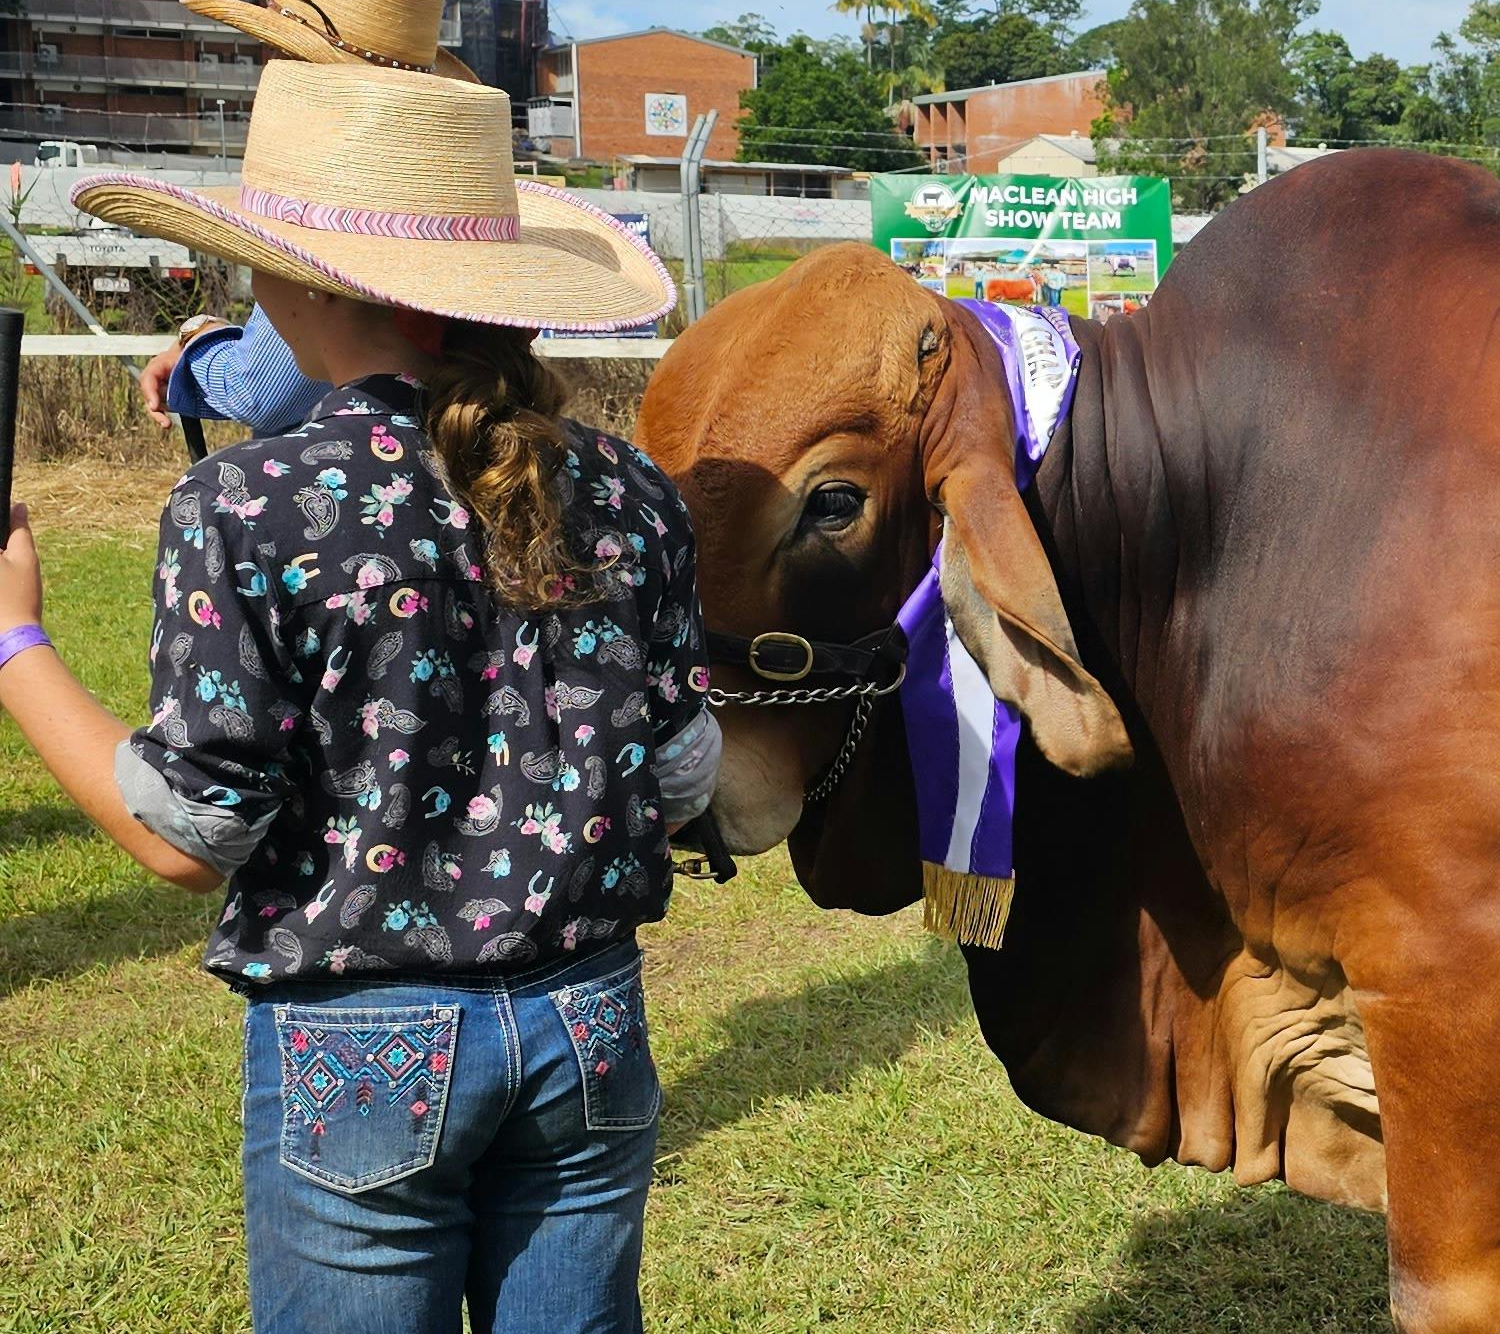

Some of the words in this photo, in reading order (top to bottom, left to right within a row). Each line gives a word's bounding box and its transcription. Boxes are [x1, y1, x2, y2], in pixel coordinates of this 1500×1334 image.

[969, 185, 1078, 207] MACLEAN
[1083, 187, 1138, 206] HIGH
[984, 209, 1055, 229] SHOW
[1060, 211, 1121, 229] TEAM
